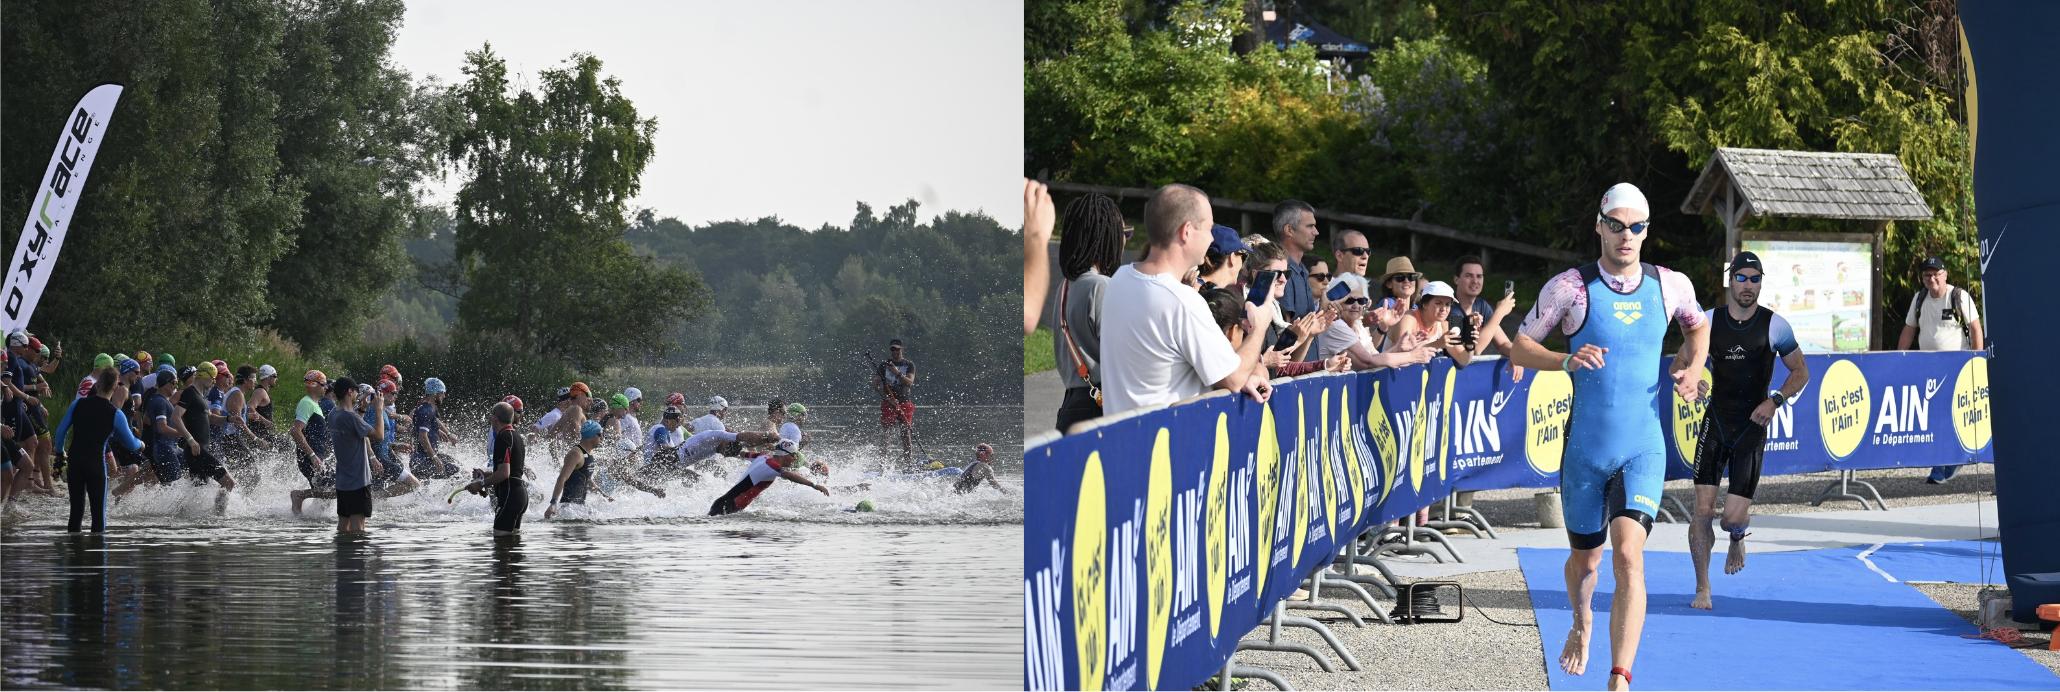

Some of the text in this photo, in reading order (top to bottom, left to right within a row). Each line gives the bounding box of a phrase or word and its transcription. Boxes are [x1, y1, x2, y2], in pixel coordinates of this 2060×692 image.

[1613, 301, 1641, 310] arena
[1824, 385, 1864, 414] Ici, c'est
[1957, 386, 1989, 408] Ici, c'es
[1531, 404, 1547, 425] Ici,
[1678, 403, 1694, 420] Ici,
[1875, 385, 1929, 434] AIN
[1832, 413, 1853, 434] l'Ain
[1536, 424, 1558, 446] l'Ain
[1873, 431, 1934, 446] le Département
[1173, 488, 1198, 618] AIN
[1107, 520, 1138, 676] AIN
